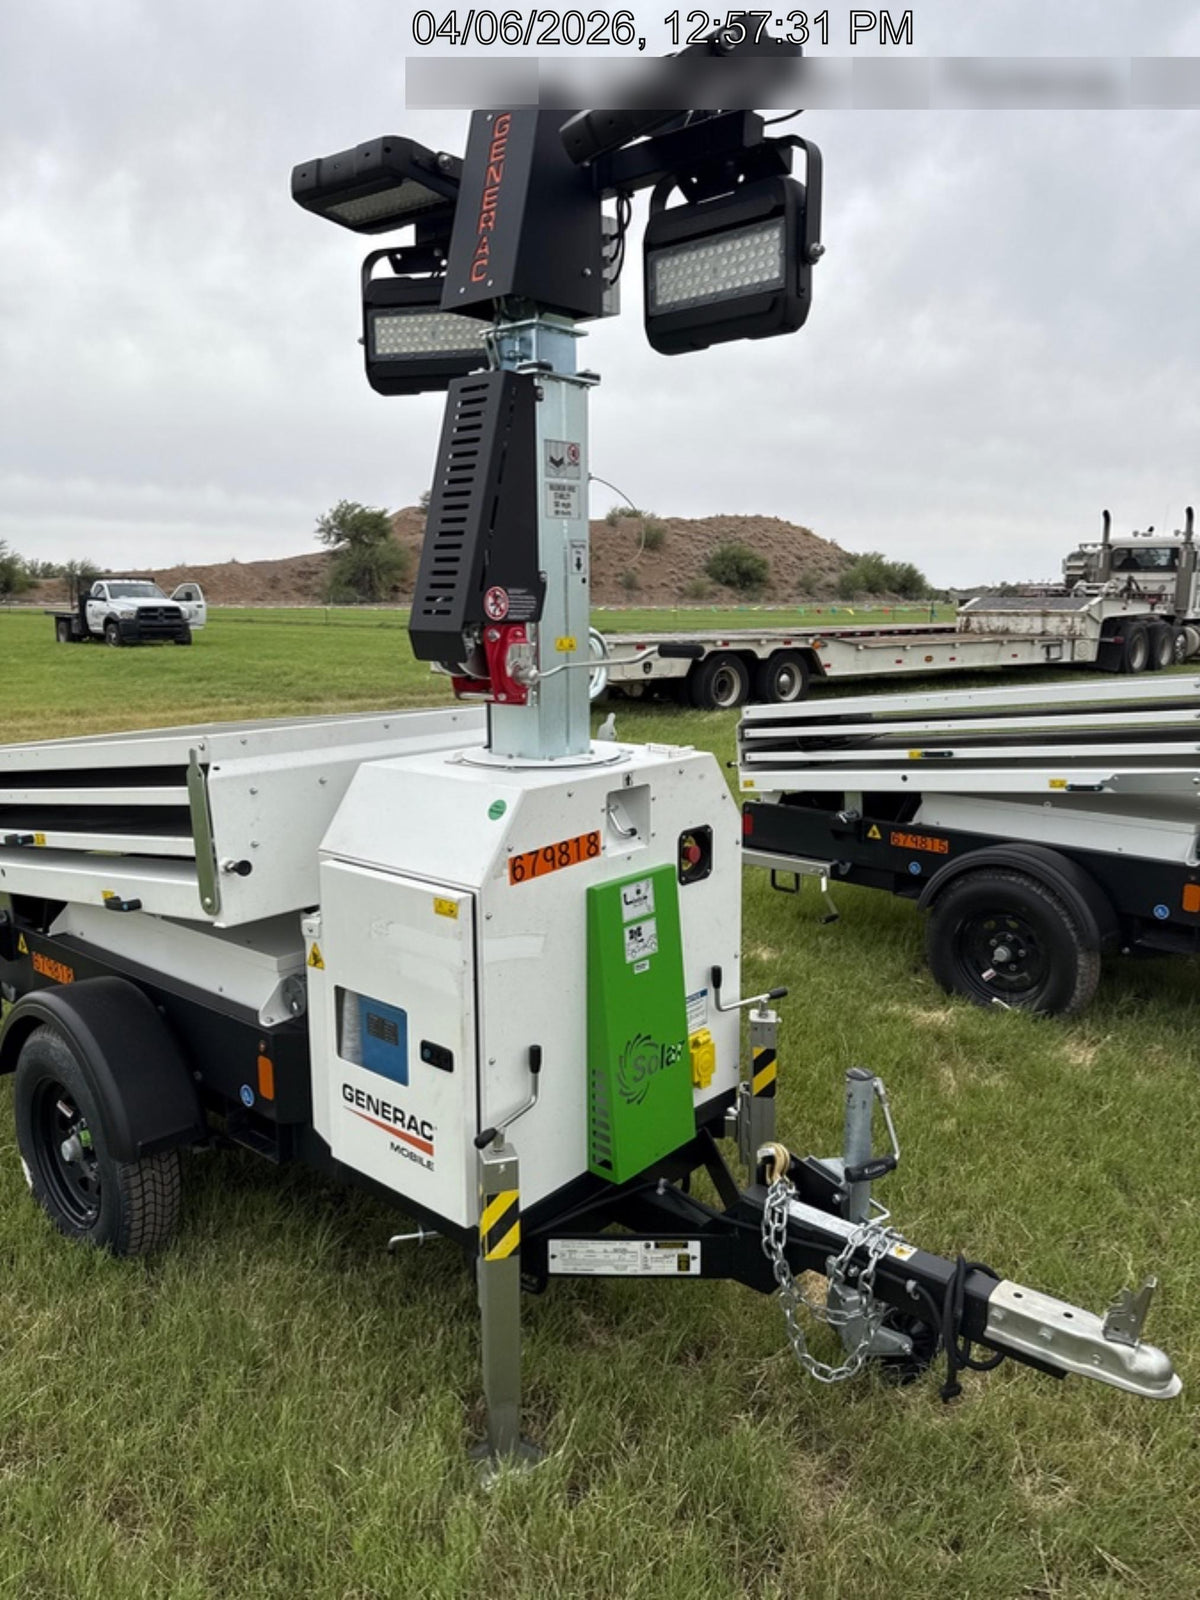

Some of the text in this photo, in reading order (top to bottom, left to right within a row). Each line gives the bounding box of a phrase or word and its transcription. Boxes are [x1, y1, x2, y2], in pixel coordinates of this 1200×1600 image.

[469, 113, 511, 281] GENERAC
[512, 831, 600, 882] 679818
[342, 1083, 434, 1142] GENERAC
[390, 1142, 434, 1171] MOBILE
